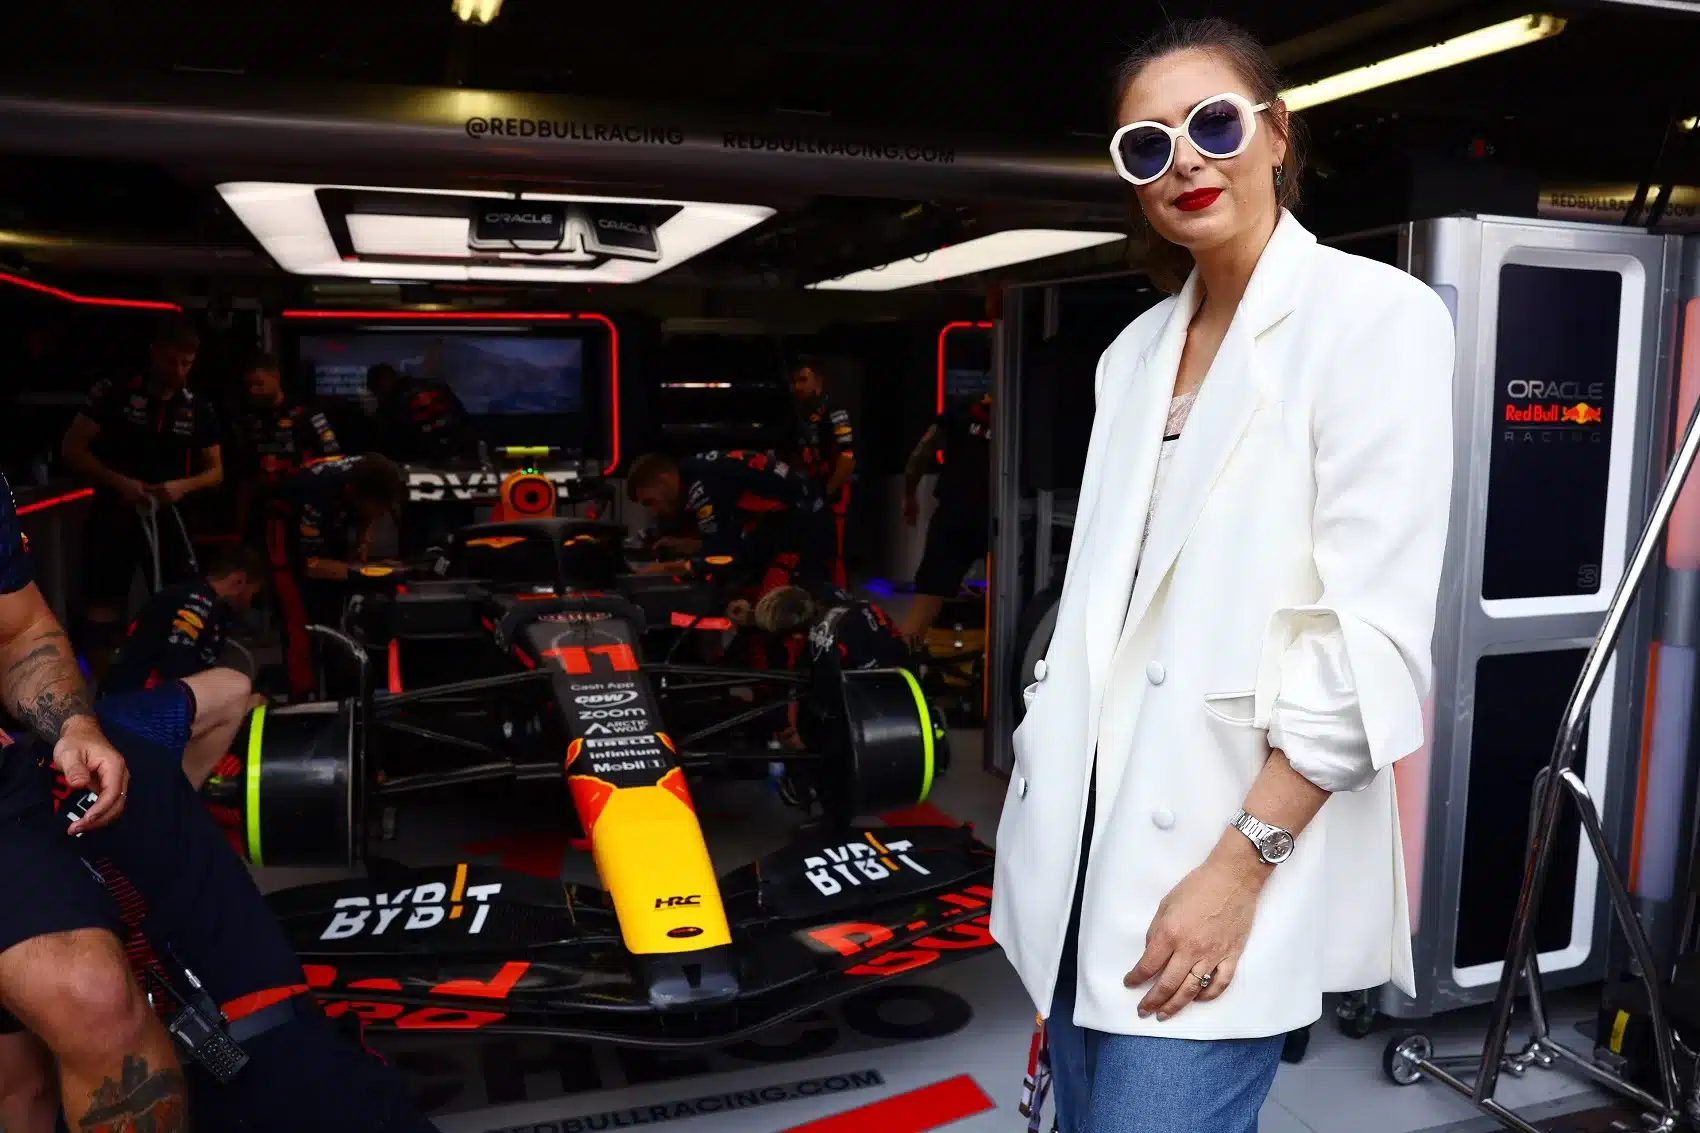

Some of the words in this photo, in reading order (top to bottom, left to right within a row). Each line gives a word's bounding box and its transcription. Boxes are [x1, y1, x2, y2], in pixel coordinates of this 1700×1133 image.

[466, 116, 684, 145] @REDBULLRACING
[723, 131, 955, 163] REDBULLRACING.COM
[485, 213, 553, 225] ORACLE
[1507, 380, 1604, 400] ORACLE
[1504, 431, 1602, 443] RACING
[541, 642, 640, 676] 11
[570, 683, 605, 692] Cash
[607, 681, 635, 690] App
[578, 707, 646, 720] zoom
[606, 719, 649, 728] ARCTIC
[612, 725, 646, 733] WOLF
[593, 760, 646, 773] Mobil
[655, 895, 702, 909] HRC
